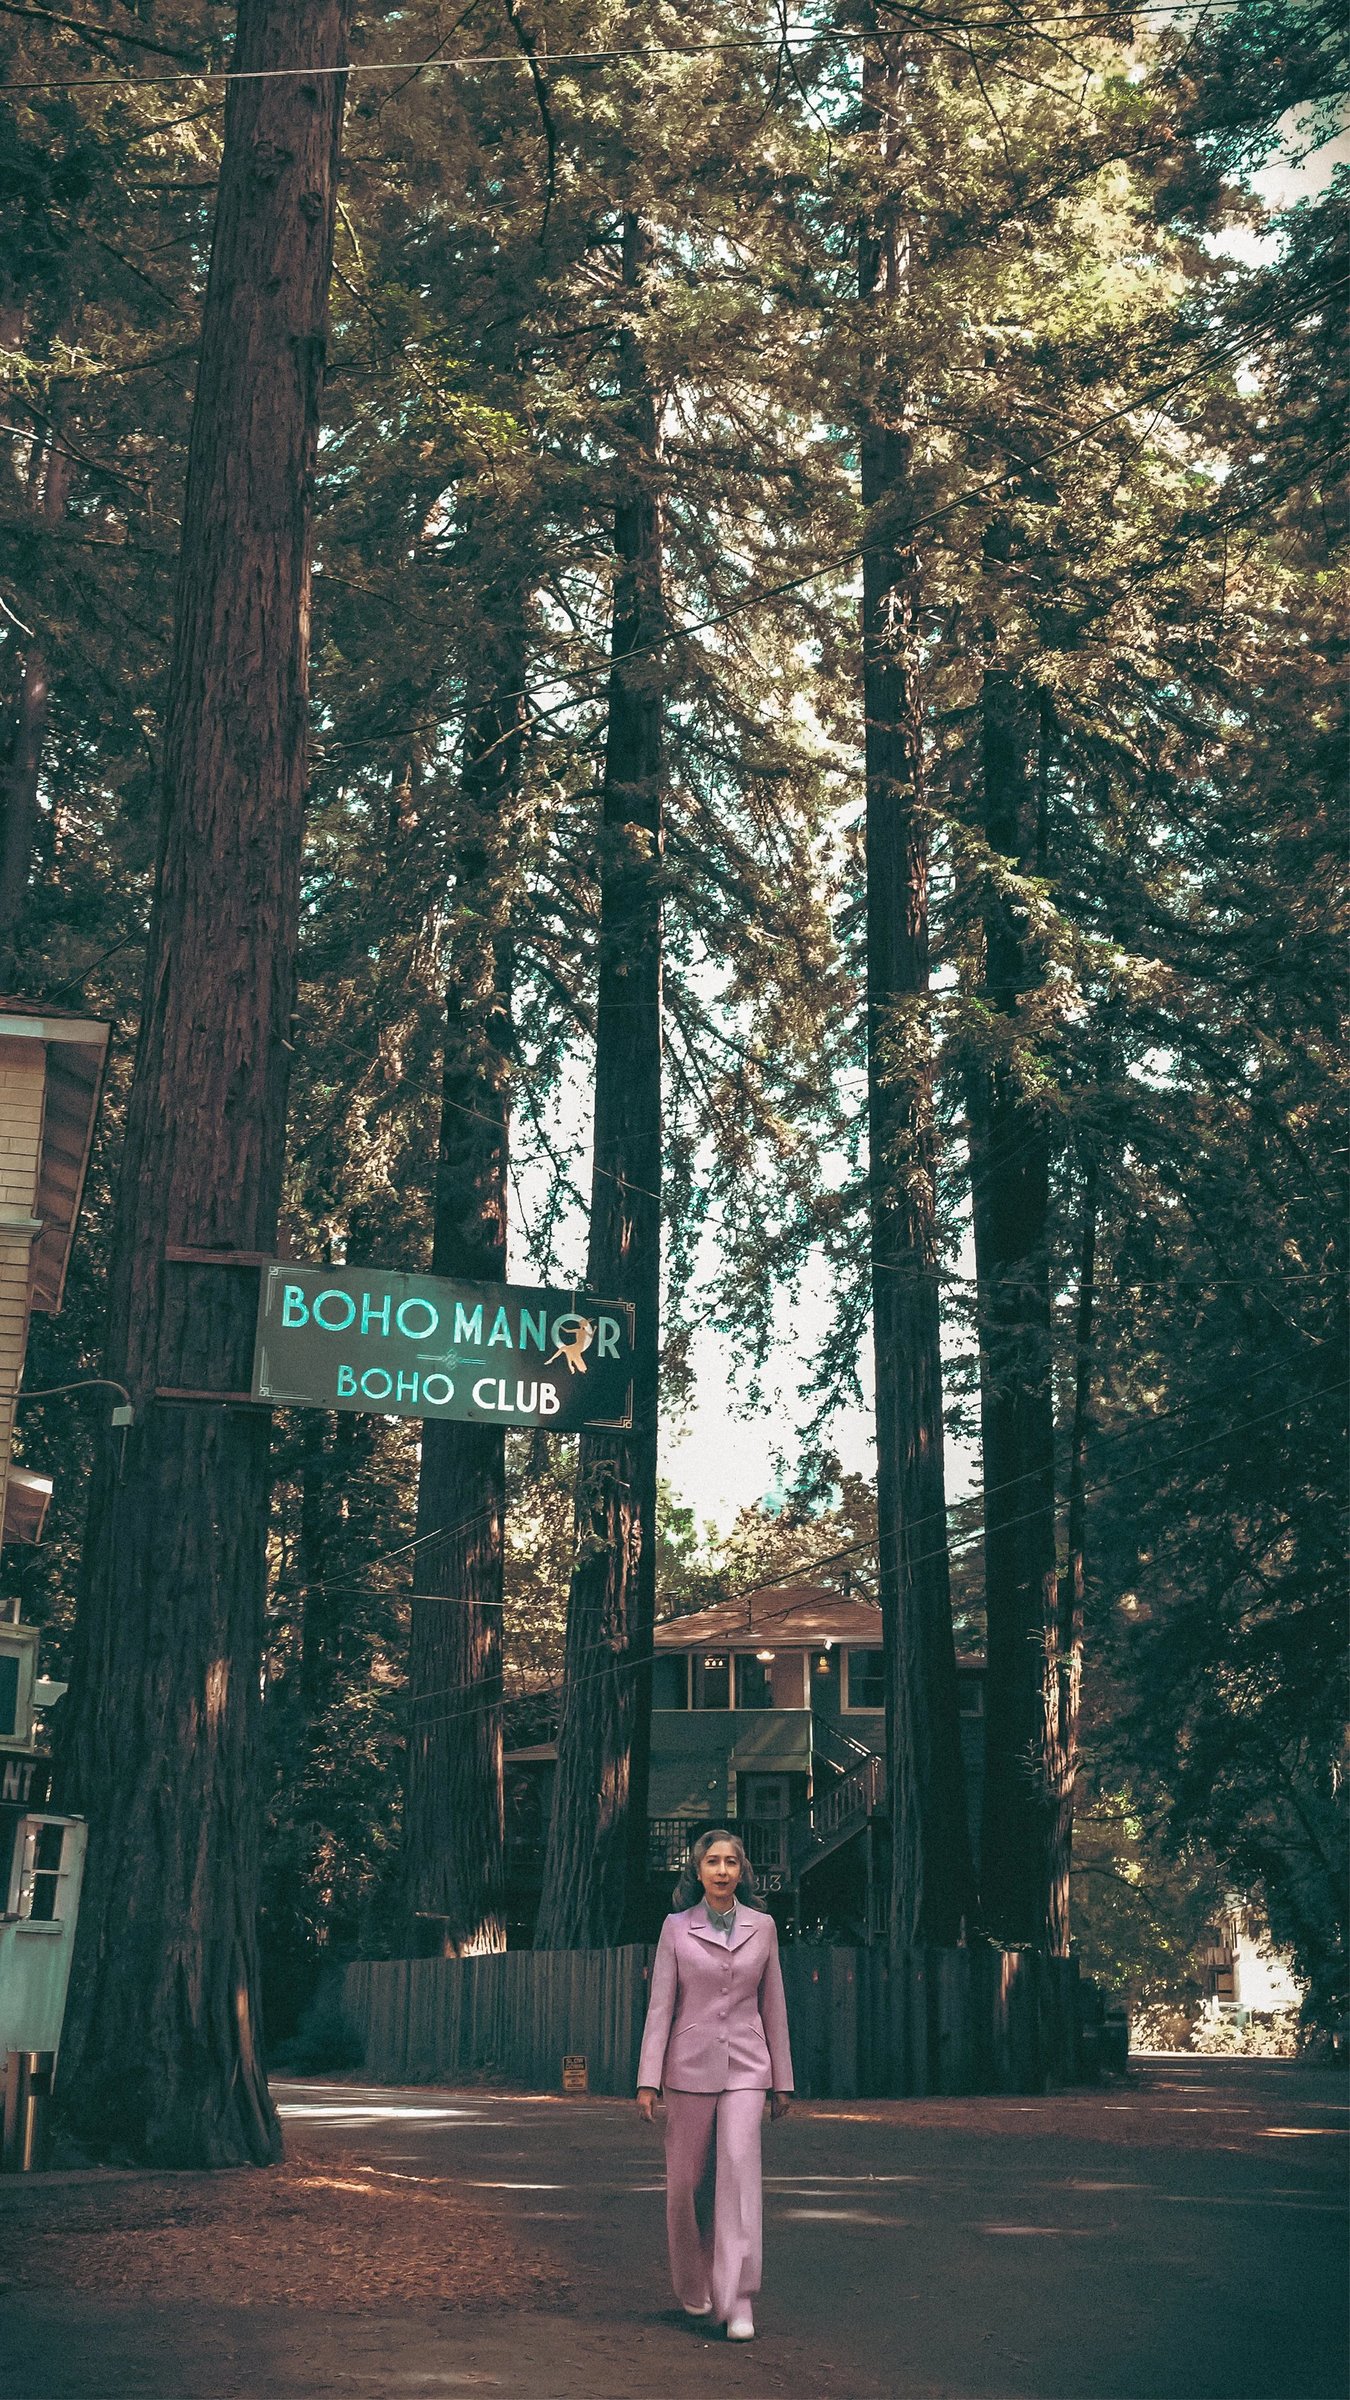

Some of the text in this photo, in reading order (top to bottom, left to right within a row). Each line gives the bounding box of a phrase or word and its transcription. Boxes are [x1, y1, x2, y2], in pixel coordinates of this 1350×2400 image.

[282, 1284, 621, 1360] BOHO MANOR
[336, 1364, 561, 1415] BOHO CLUB
